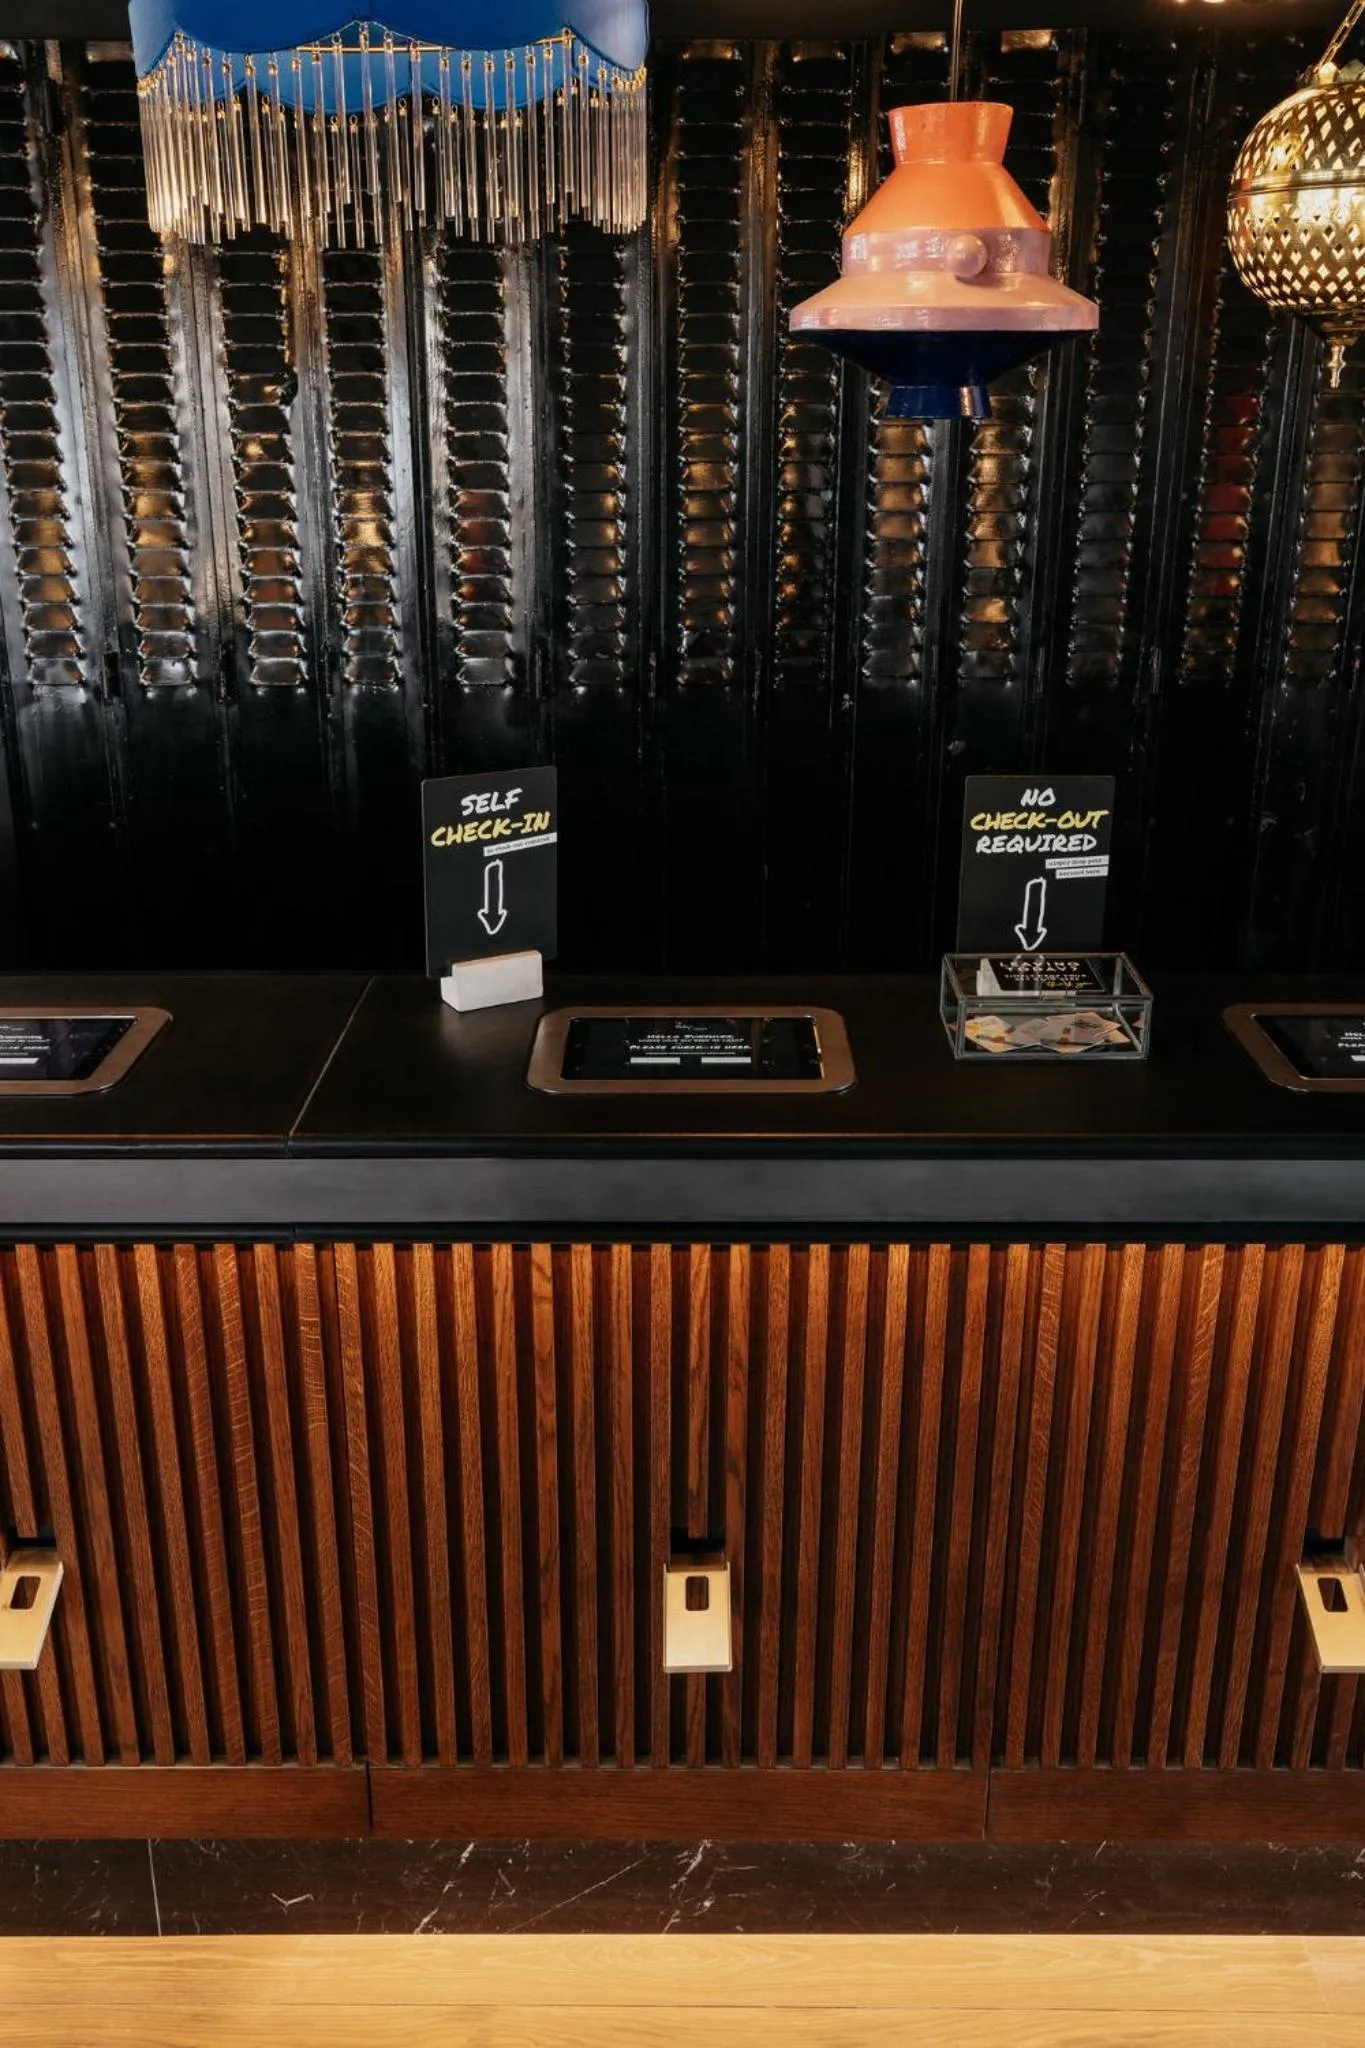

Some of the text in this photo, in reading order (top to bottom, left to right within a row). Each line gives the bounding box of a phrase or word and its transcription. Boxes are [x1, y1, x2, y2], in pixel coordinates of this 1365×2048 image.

[460, 787, 523, 816] SELF
[1020, 787, 1056, 807] NO
[430, 810, 551, 847] CHECK-IN
[970, 809, 1110, 831] CHECK-OUT
[975, 833, 1098, 854] REQUIRED
